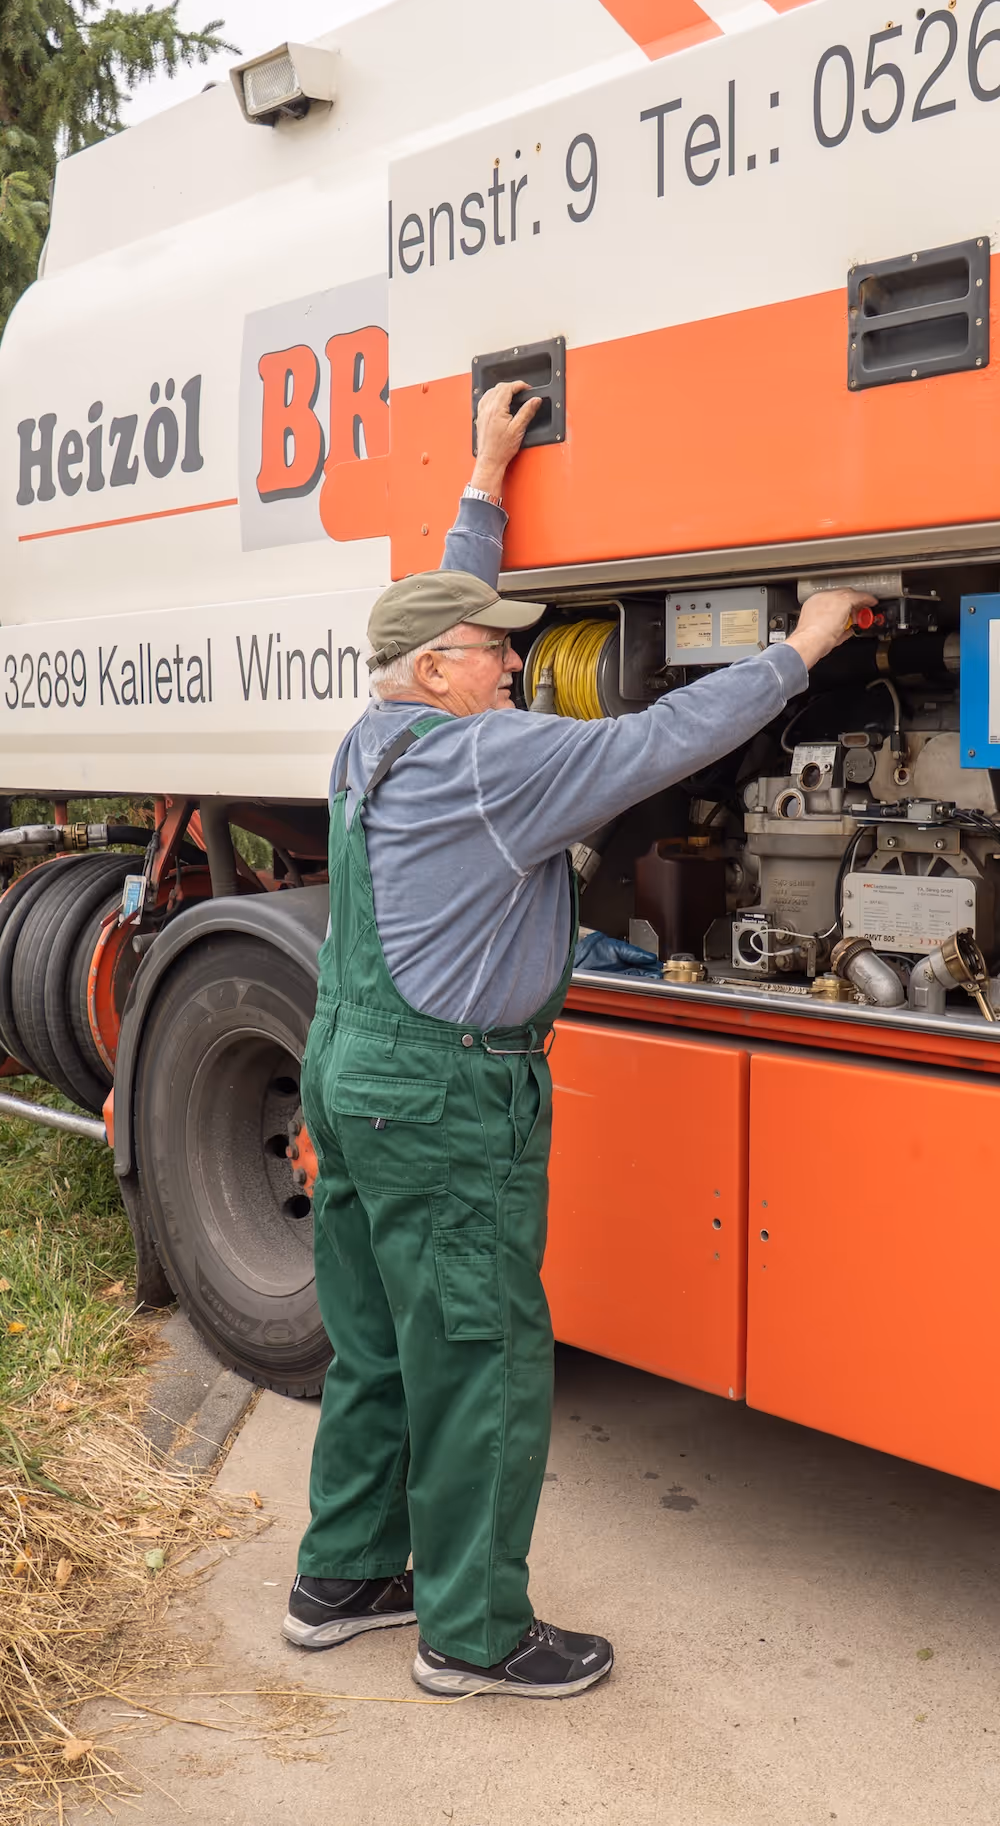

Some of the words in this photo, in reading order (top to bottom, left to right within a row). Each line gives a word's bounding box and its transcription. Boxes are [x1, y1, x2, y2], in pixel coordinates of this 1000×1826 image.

[565, 132, 598, 223] 9
[639, 79, 780, 198] Tel.:
[813, 0, 1000, 148] 0526
[16, 374, 205, 506] Heizöl
[4, 648, 87, 710] 32689
[98, 637, 213, 706] Kalletal
